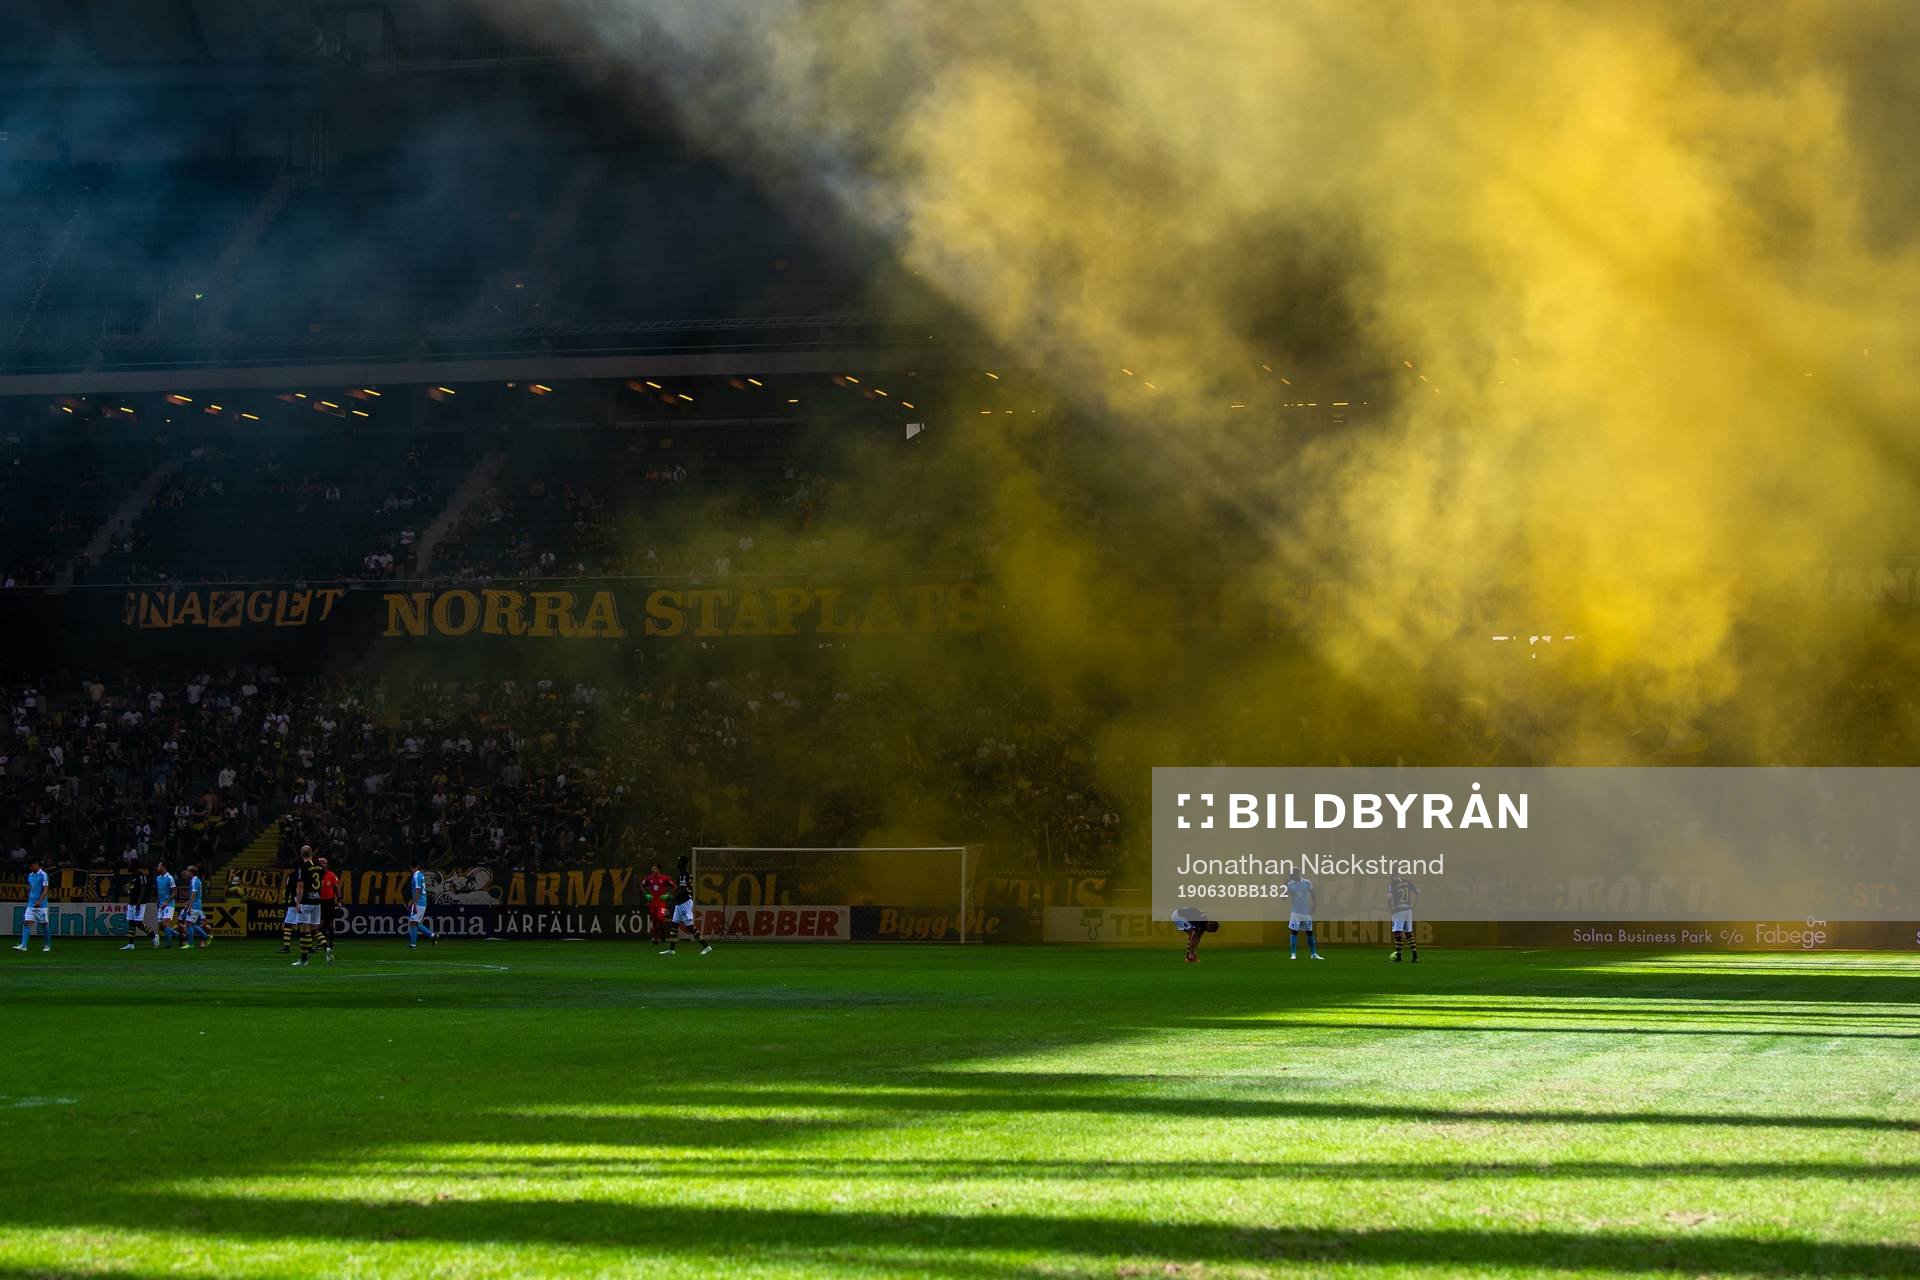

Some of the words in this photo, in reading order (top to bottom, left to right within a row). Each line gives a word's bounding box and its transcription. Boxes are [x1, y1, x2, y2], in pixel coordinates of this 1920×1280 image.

[384, 587, 624, 638] NORRA
[311, 872, 321, 890] 3
[508, 865, 633, 907] ARMY
[494, 910, 602, 935] JÄRFÄLLA
[1315, 911, 1434, 944] LLENTB
[1572, 928, 1613, 944] Solna
[1618, 928, 1676, 944] Business
[1681, 928, 1713, 944] Park
[1756, 923, 1827, 948] Fabege
